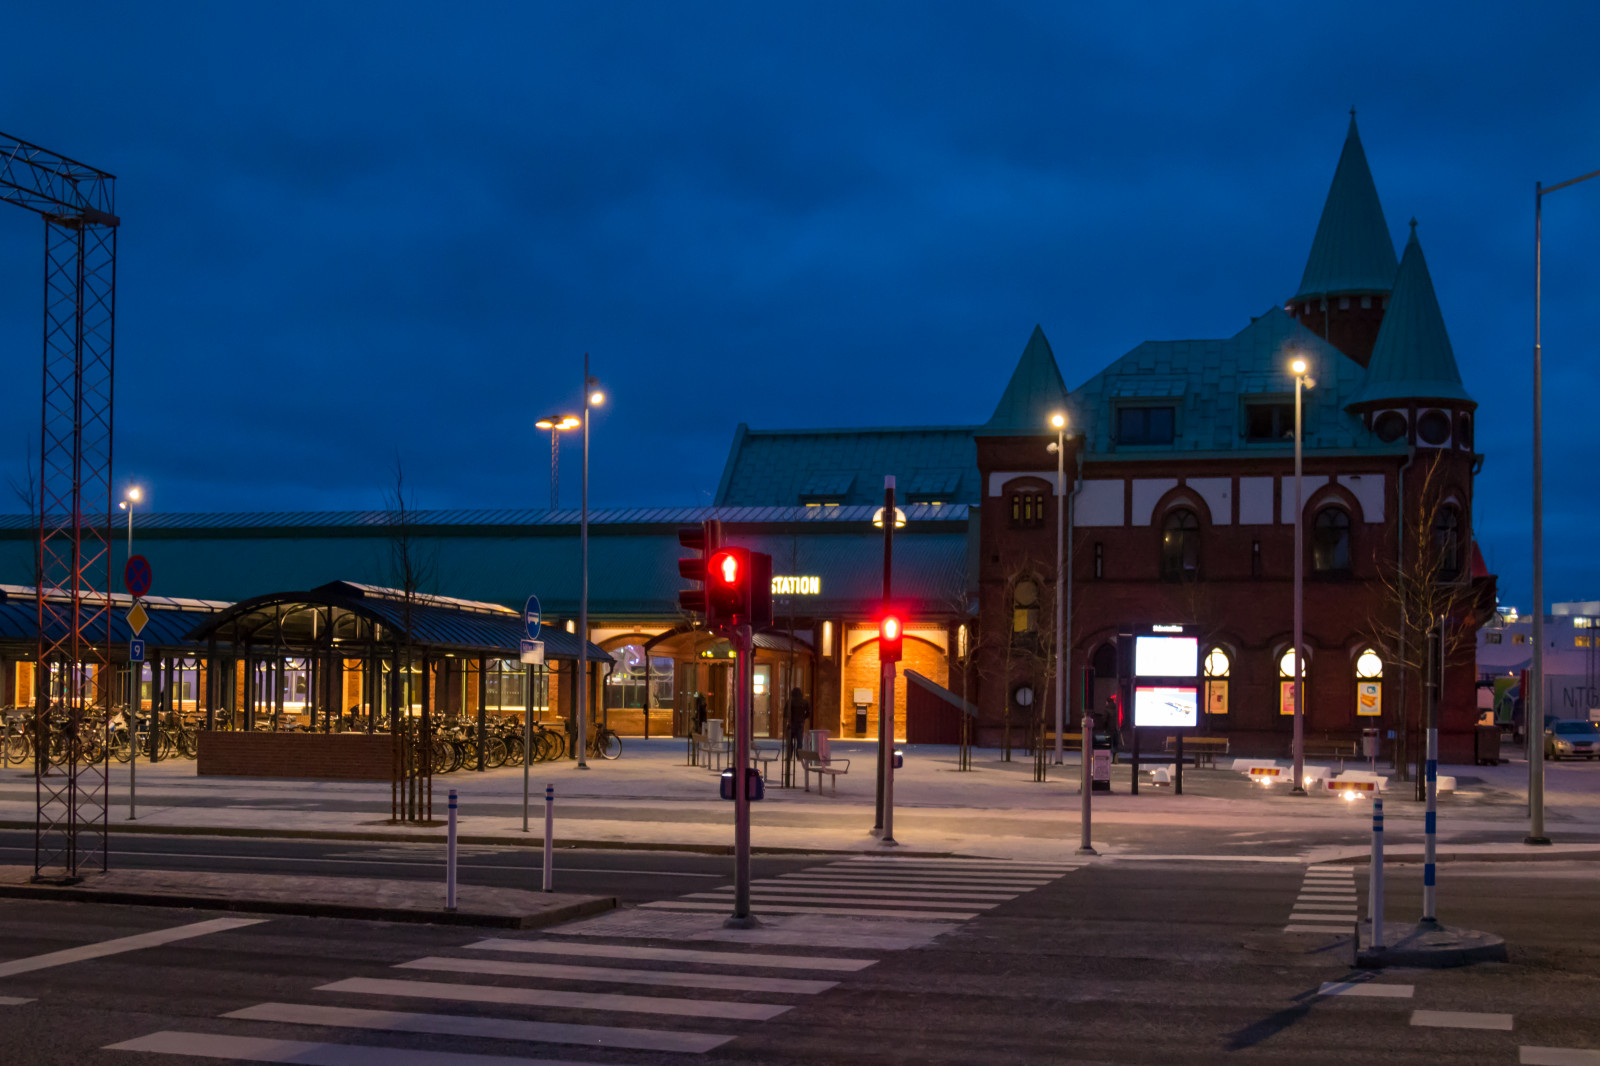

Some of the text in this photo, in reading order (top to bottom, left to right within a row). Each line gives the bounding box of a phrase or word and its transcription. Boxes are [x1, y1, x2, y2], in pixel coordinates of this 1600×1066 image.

[771, 576, 820, 594] STATION
[135, 645, 140, 656] 9
[1563, 687, 1599, 707] NTG
